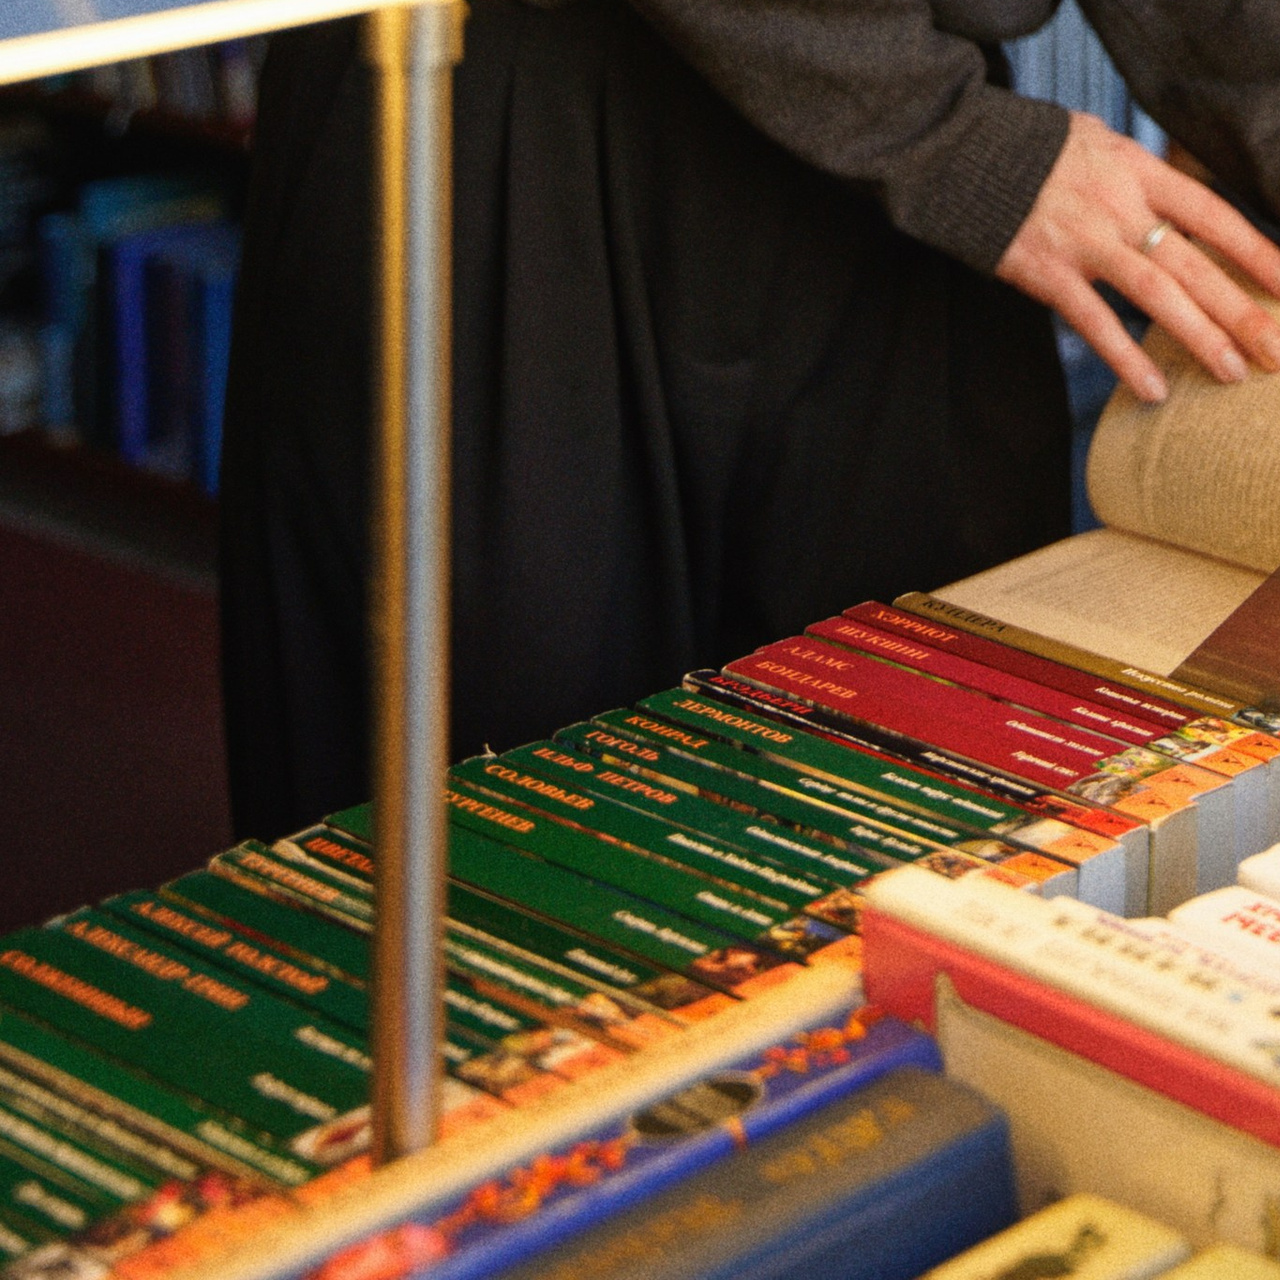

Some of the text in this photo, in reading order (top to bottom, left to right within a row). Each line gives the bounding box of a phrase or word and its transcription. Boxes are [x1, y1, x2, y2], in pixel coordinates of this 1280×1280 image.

[836, 625, 931, 661] ШУКШИН
[871, 609, 959, 643] ХЭРРИОТ
[782, 645, 855, 671] АДАМС
[755, 659, 858, 700] БОНДАРЕВ
[624, 715, 710, 750] КОНРАД
[673, 699, 794, 745] ЛЕРМОНТОВ
[585, 730, 660, 762] ГОГОЛЬ
[485, 765, 595, 811] СОЛОВЬЕВ
[532, 747, 595, 774] ИЛЬФ
[596, 771, 678, 806] ПЕТРОВ
